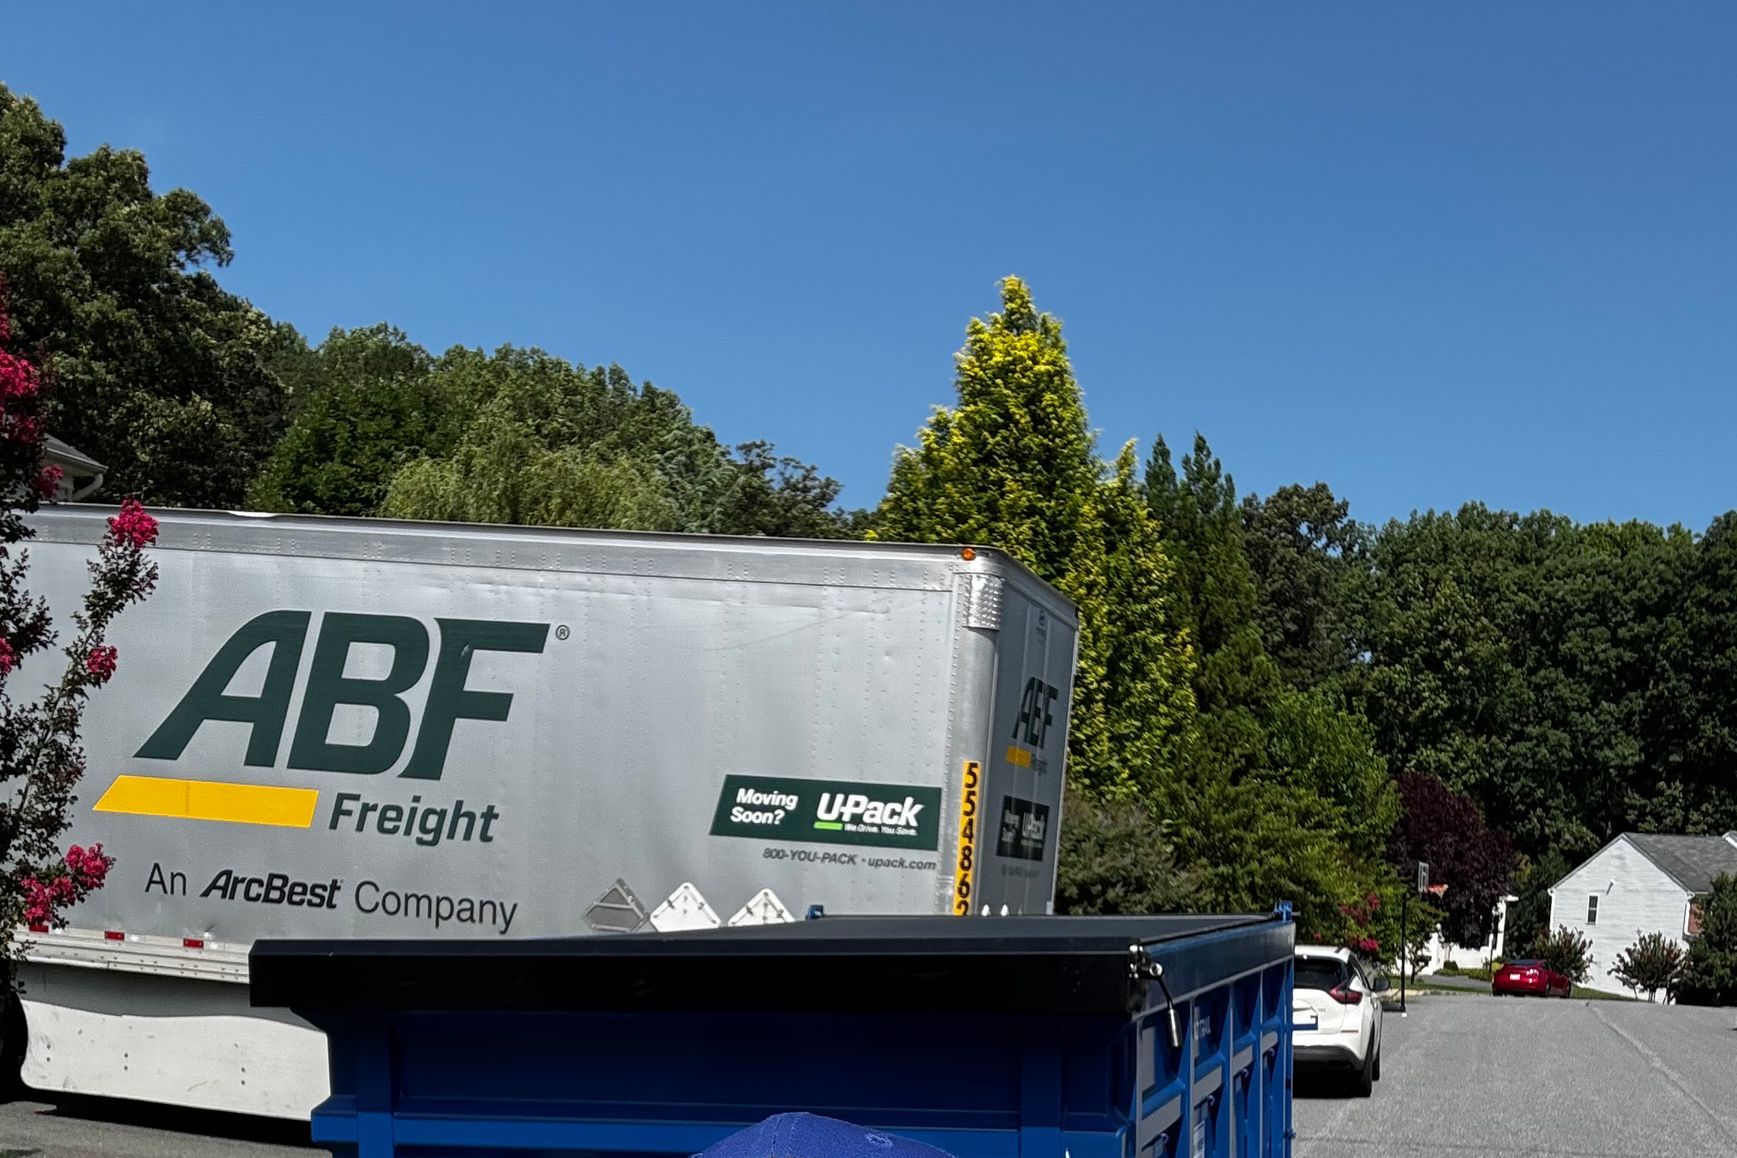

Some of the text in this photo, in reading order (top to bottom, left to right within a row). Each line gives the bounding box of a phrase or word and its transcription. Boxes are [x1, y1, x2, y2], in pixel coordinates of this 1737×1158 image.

[736, 788, 799, 810] Moving
[329, 792, 499, 847] Freight
[730, 807, 785, 825] Soon?
[763, 848, 936, 870] 800-YOU-PACK upack.com
[145, 862, 518, 934] An ArcBest Company
